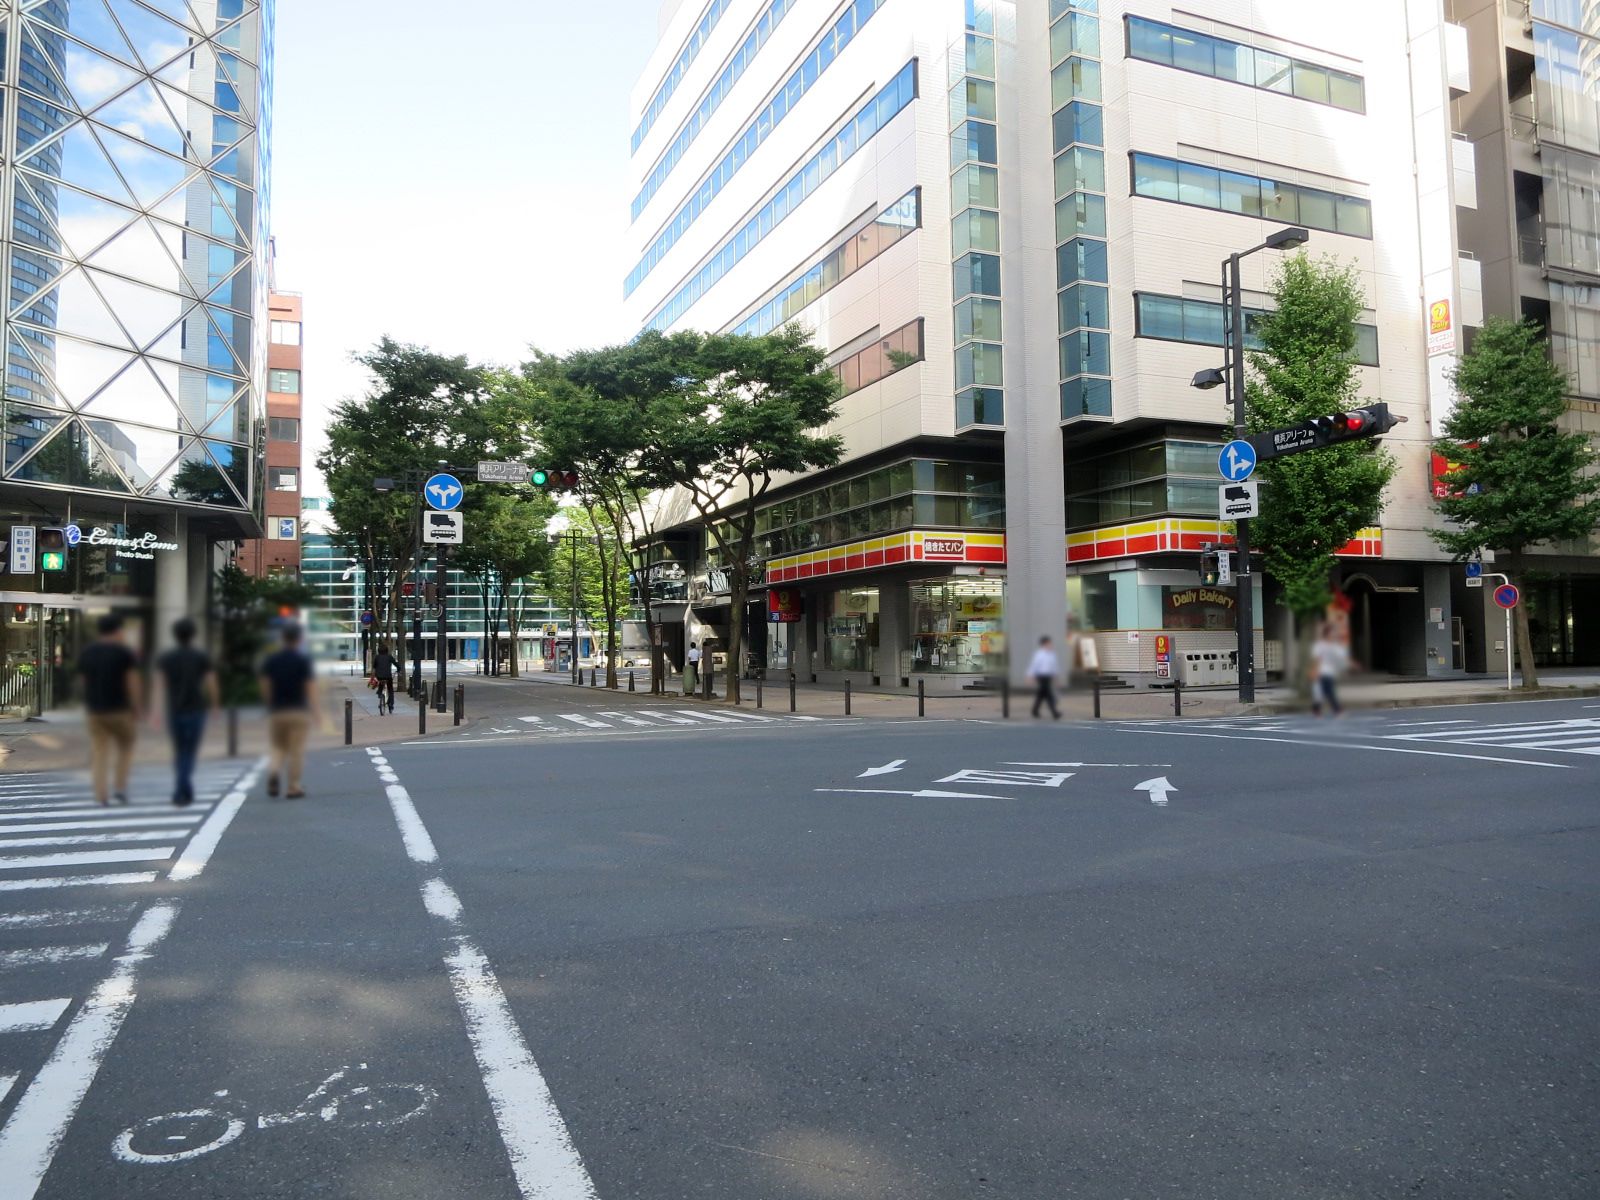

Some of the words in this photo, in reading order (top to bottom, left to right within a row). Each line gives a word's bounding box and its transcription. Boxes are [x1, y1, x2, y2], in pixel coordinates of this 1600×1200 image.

[480, 463, 526, 475] 横浜アリーナ前
[925, 541, 964, 552] 焼きたてパン
[116, 550, 134, 558] Photo
[135, 552, 154, 560] Studio
[1173, 590, 1197, 607] Daily
[1199, 588, 1234, 608] Bakery
